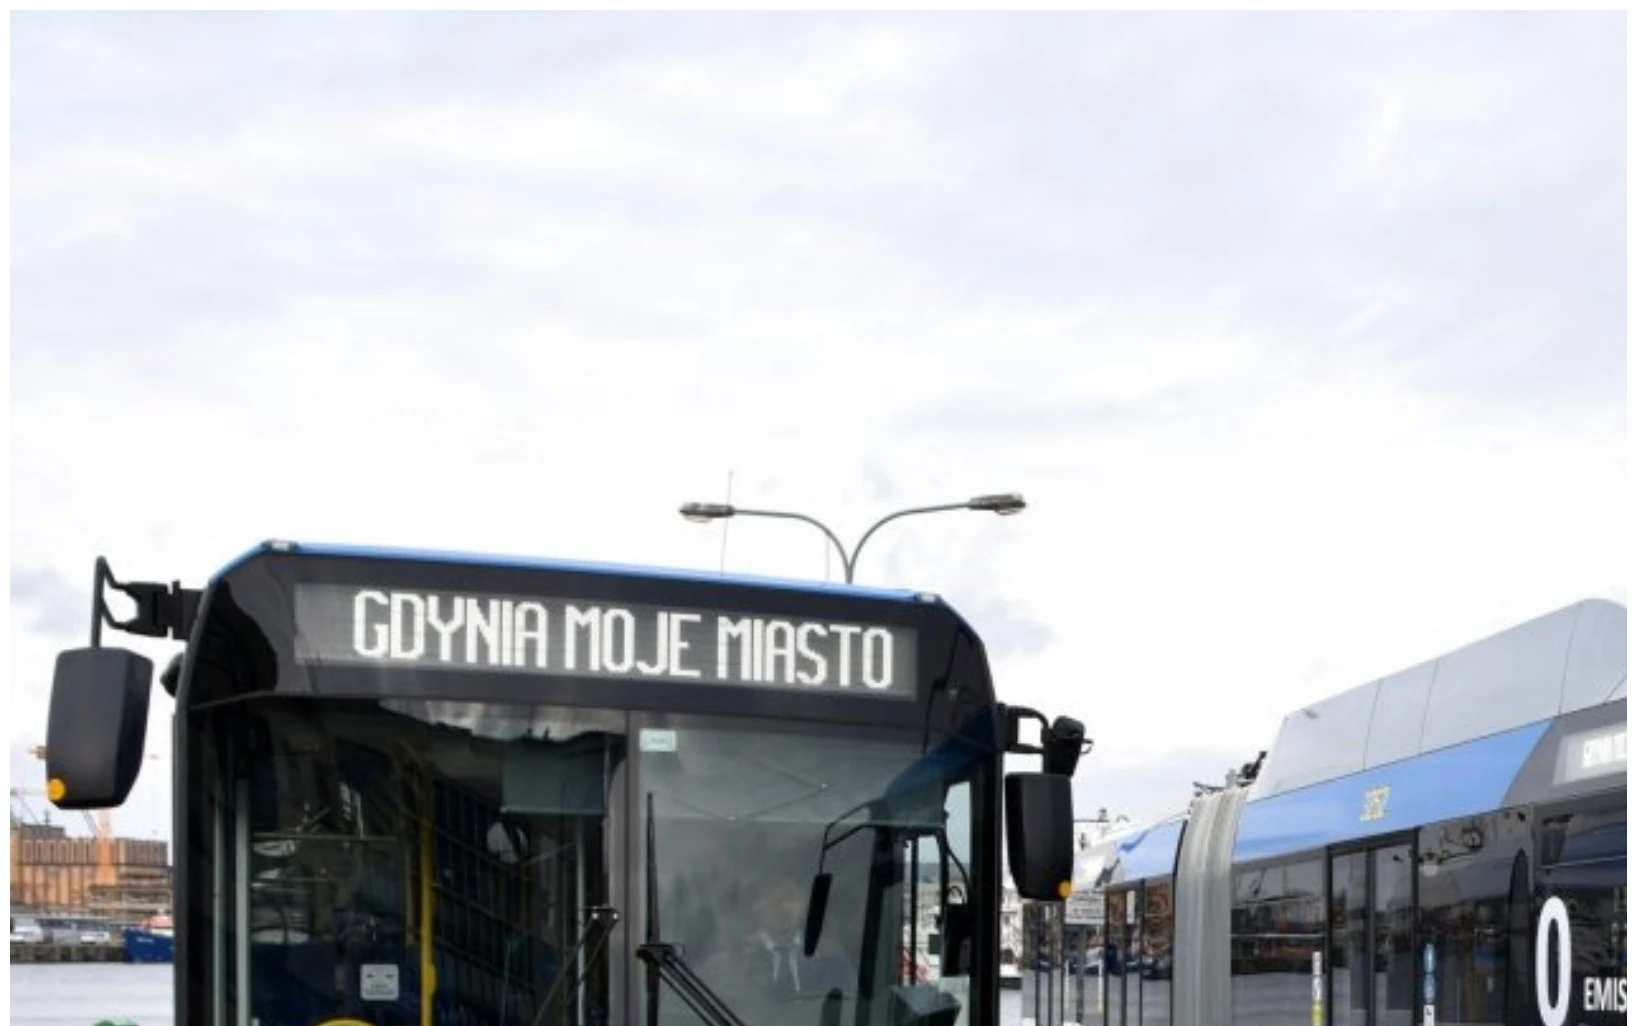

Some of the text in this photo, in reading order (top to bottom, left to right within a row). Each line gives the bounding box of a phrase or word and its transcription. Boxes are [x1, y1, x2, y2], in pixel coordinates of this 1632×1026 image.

[353, 589, 894, 690] GDYNIA MOJE MIASTO
